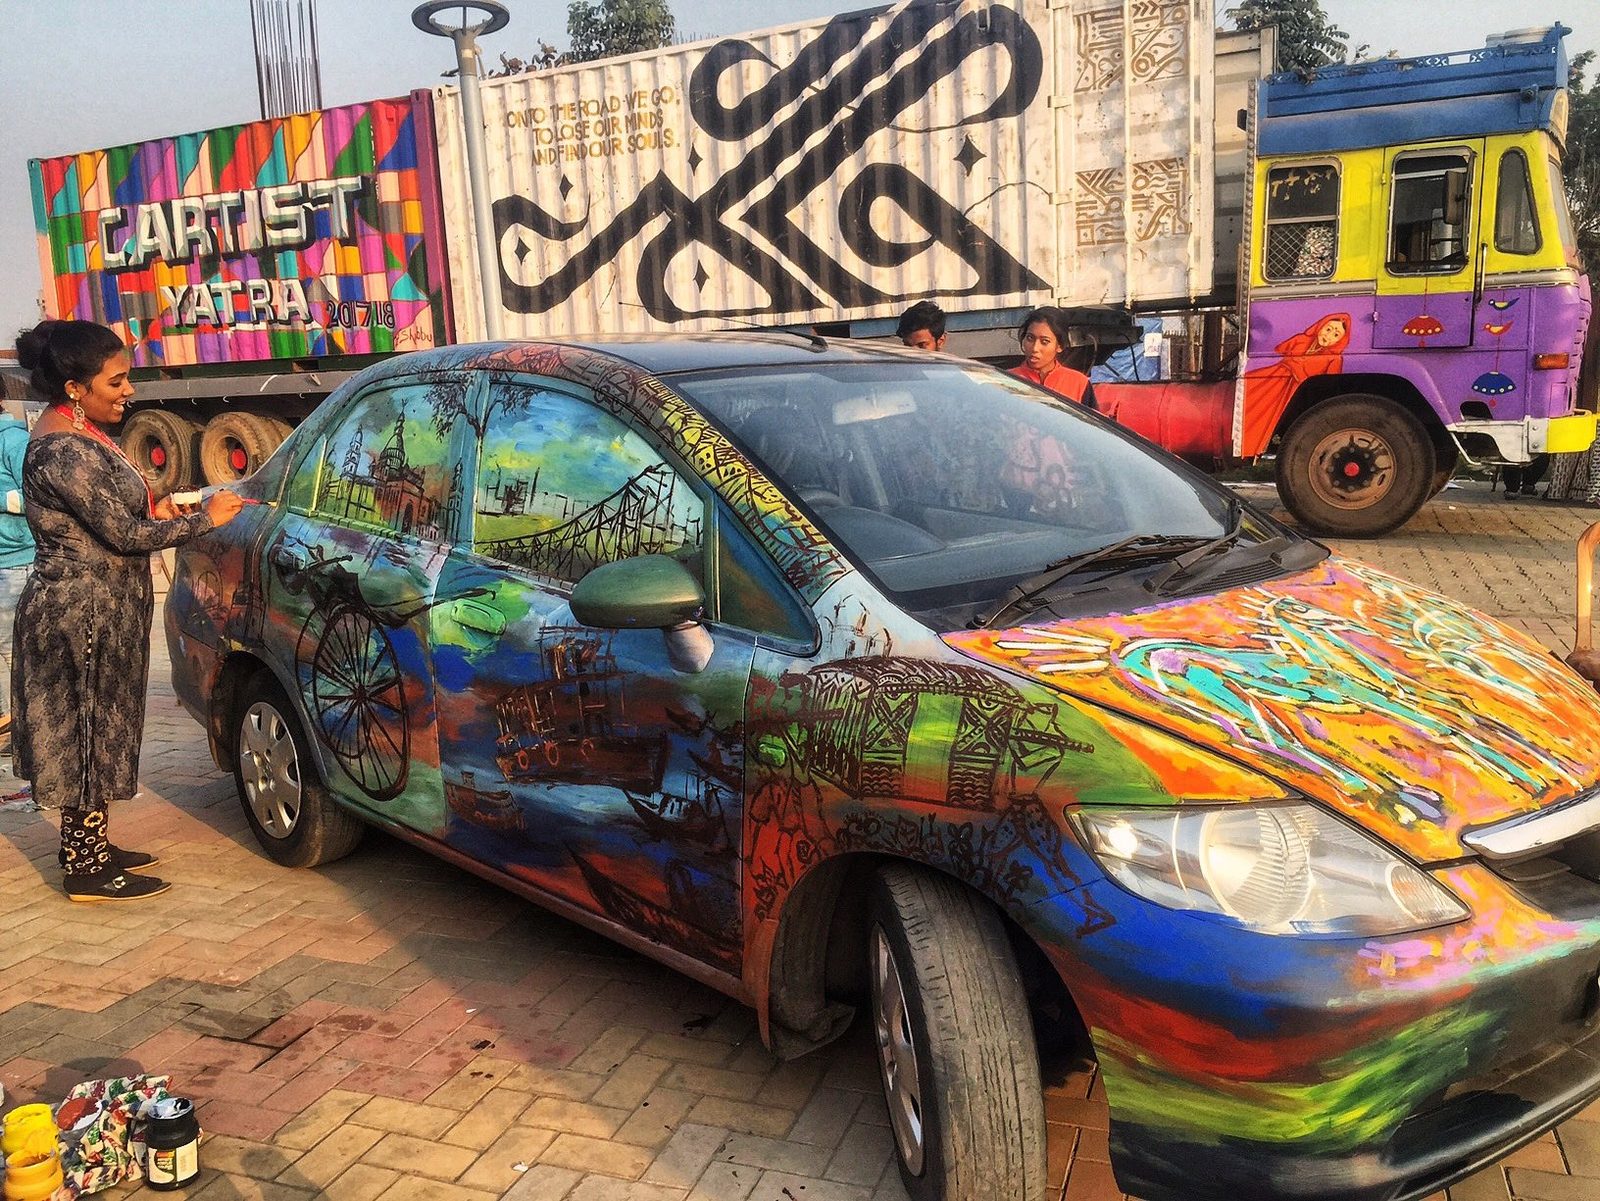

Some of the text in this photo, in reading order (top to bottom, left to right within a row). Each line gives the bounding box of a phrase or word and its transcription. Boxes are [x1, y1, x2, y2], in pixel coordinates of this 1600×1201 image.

[507, 107, 545, 128] ONTO
[550, 103, 576, 121] THE
[578, 95, 621, 118] ROAD
[625, 90, 648, 111] WE
[533, 108, 664, 146] TO LOSE OUR MINDS
[532, 148, 557, 167] AND
[557, 143, 588, 163] FIND
[589, 138, 624, 158] OUR
[98, 175, 369, 274] CARTIST
[162, 278, 313, 328] YATRA
